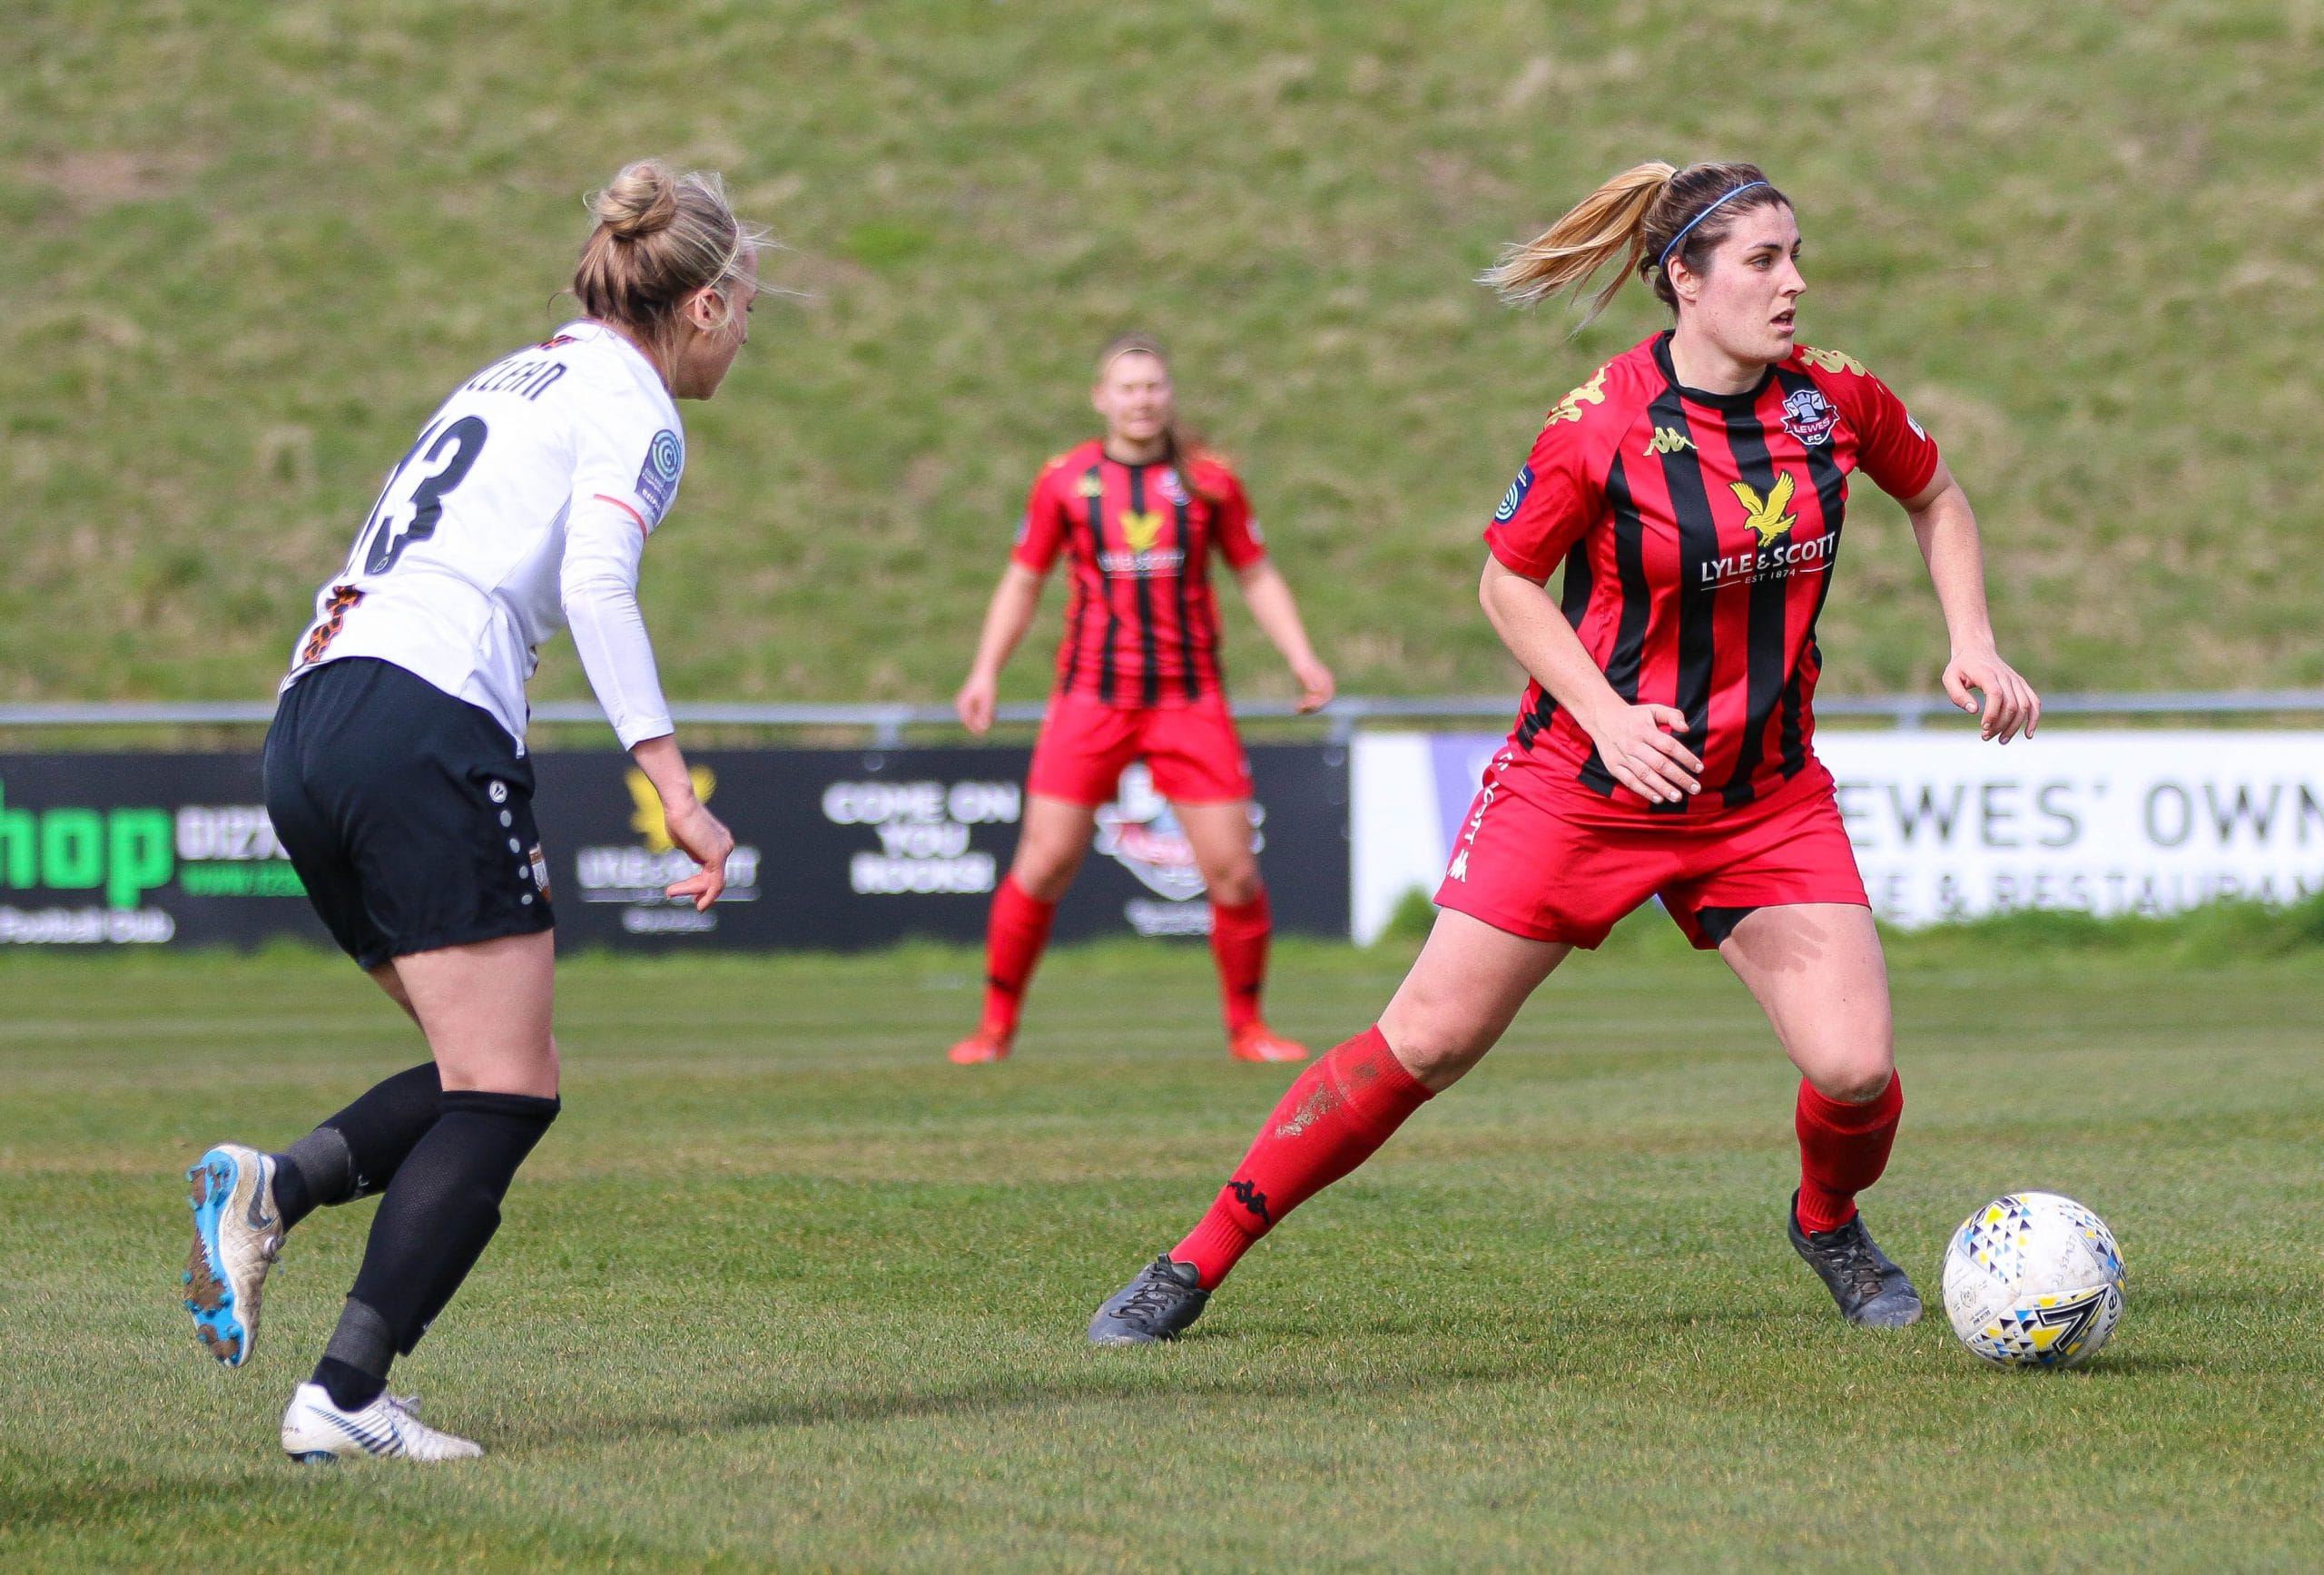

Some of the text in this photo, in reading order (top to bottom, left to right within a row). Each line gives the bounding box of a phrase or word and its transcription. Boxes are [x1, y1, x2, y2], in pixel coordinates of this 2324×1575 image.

[1793, 417, 1830, 434] LEWES
[1807, 433, 1822, 443] FC
[343, 414, 488, 576] 13
[1701, 530, 1836, 583] LYLE & SCOTT
[1745, 567, 1796, 585] EST 1874
[824, 783, 1020, 822] COME ON
[1837, 779, 2112, 851] EWES'
[0, 783, 172, 909] hop
[178, 805, 290, 861] 0127
[877, 821, 970, 858] YOU
